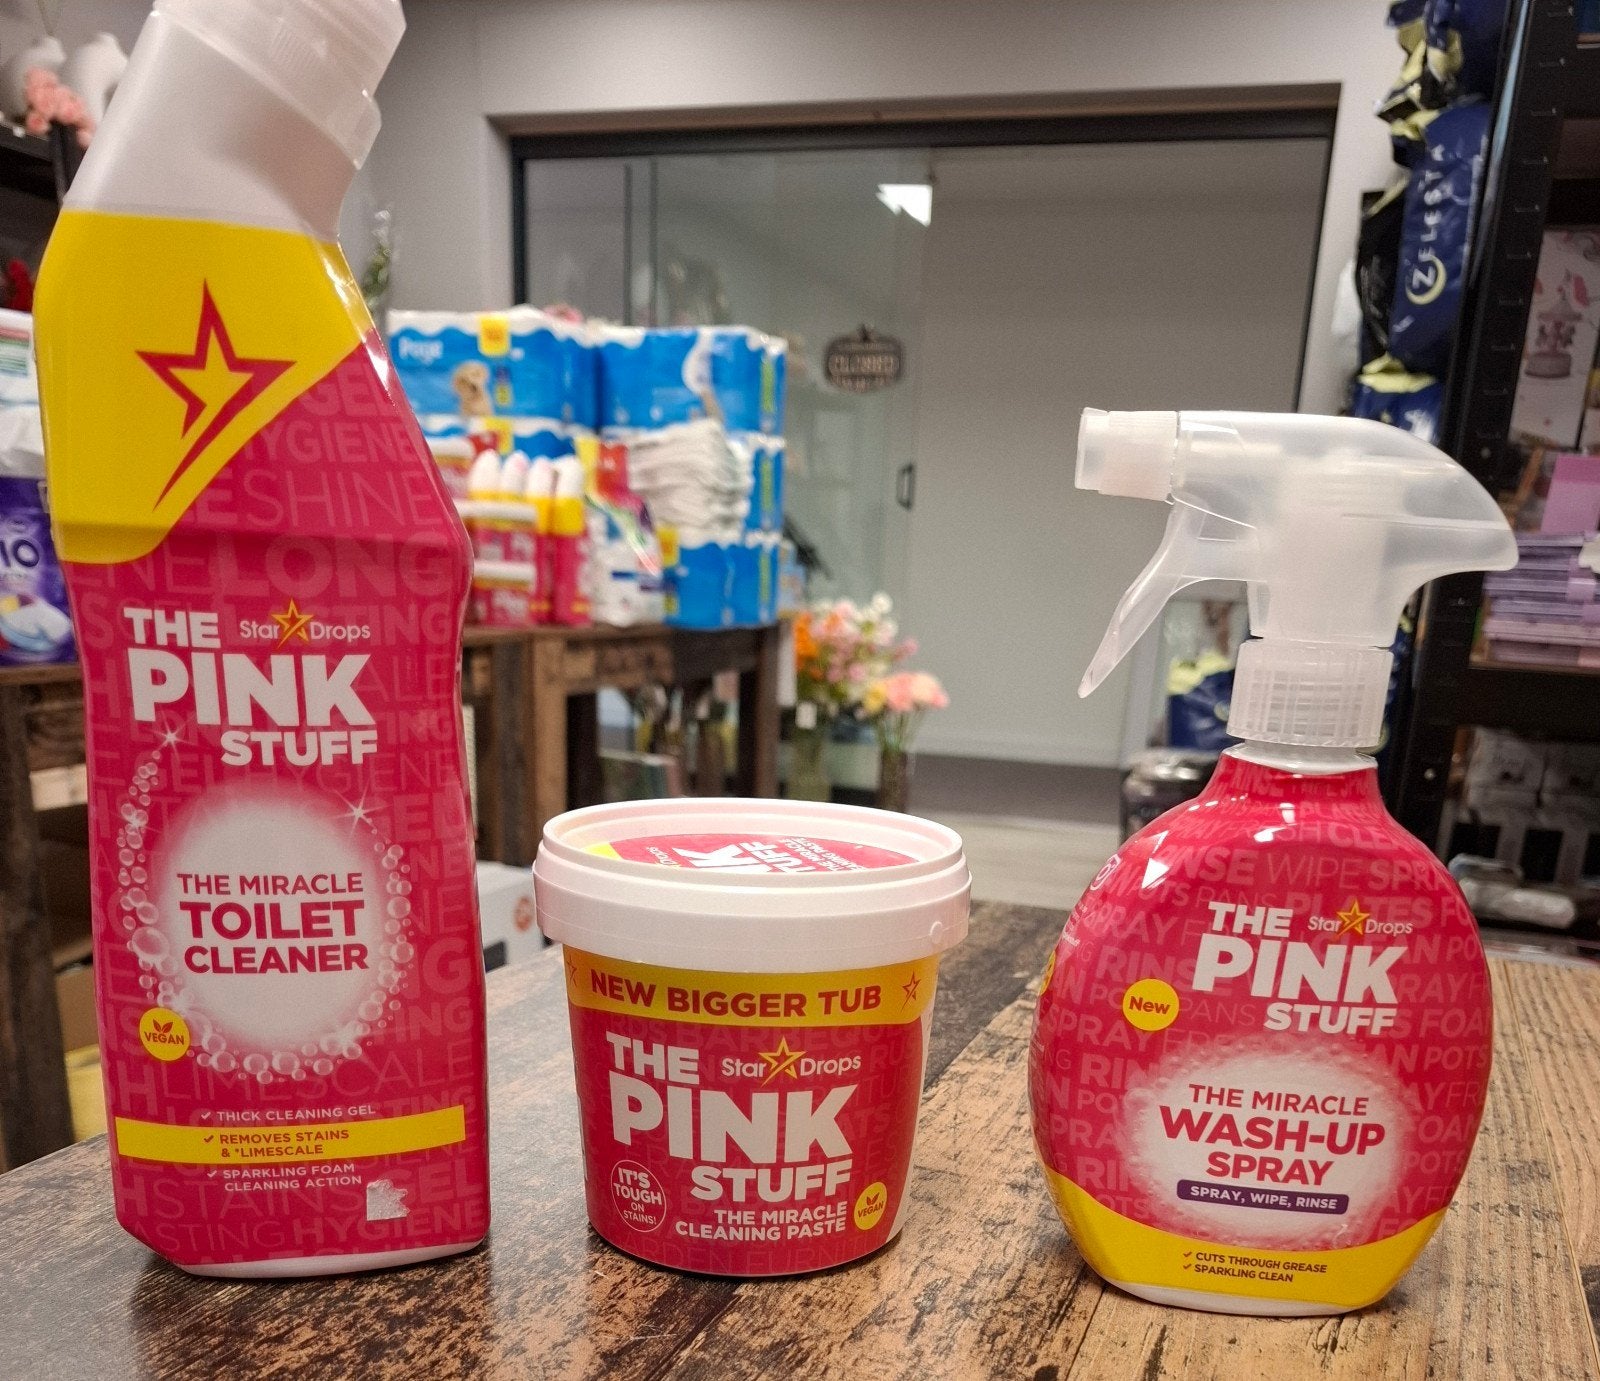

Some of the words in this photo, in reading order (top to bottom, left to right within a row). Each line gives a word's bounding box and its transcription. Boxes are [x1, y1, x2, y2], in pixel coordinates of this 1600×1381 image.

[123, 606, 222, 649] THE
[239, 620, 279, 640] Star
[310, 621, 371, 642] Drops
[127, 648, 375, 727] PINK
[220, 730, 378, 767] STUFF
[177, 872, 231, 895] THE
[239, 872, 364, 896] MIRACLE
[179, 900, 365, 940] TOILET
[1207, 900, 1294, 937] THE
[1308, 915, 1340, 933] Star
[1365, 918, 1413, 937] Drops
[184, 942, 370, 975] CLEANER
[1192, 935, 1407, 1004] PINK
[590, 968, 656, 1008] NEW
[667, 986, 808, 1018] BIGGER
[818, 985, 882, 1016] TUB
[1128, 995, 1171, 1015] New
[1264, 1002, 1398, 1036] STUFF
[144, 1031, 185, 1047] VEGAN
[605, 1030, 700, 1085] THE
[721, 1057, 767, 1078] Star
[800, 1054, 862, 1077] Drops
[1188, 1084, 1245, 1108] THE
[1251, 1090, 1369, 1116] MIRACLE
[216, 1110, 261, 1122] THICK
[265, 1107, 344, 1121] CLEANING
[347, 1104, 376, 1116] GEL
[608, 1070, 859, 1164] PINK
[219, 1132, 291, 1145] REMOVES
[295, 1129, 350, 1143] STAINS
[1159, 1106, 1385, 1155] WASH-UP
[220, 1147, 231, 1159] &
[223, 1166, 307, 1180] SPARKLING
[311, 1163, 355, 1176] FOAM
[618, 1167, 651, 1189] IT'S
[690, 1158, 853, 1202] STUFF
[1205, 1151, 1335, 1186] SPRAY
[224, 1179, 302, 1192] CLEANING
[305, 1175, 362, 1189] ACTION
[613, 1182, 663, 1206] TOUGH
[631, 1201, 645, 1212] ON
[857, 1201, 885, 1218] VEGAN
[1190, 1186, 1246, 1204] SPRAY,
[1249, 1191, 1293, 1208] WIPE,
[1295, 1195, 1338, 1210] RINSE
[623, 1208, 657, 1226] STAINS!
[714, 1208, 756, 1225] THE
[758, 1201, 848, 1225] MIRACLE
[675, 1220, 781, 1241] CLEANING
[786, 1216, 847, 1240] PASTE
[1194, 1264, 1257, 1280] SPARKLING
[1258, 1270, 1294, 1283] CLEAN
[1195, 1252, 1225, 1264] CUTS
[1228, 1255, 1281, 1270] THROUGH
[1282, 1260, 1328, 1274] GREASE
